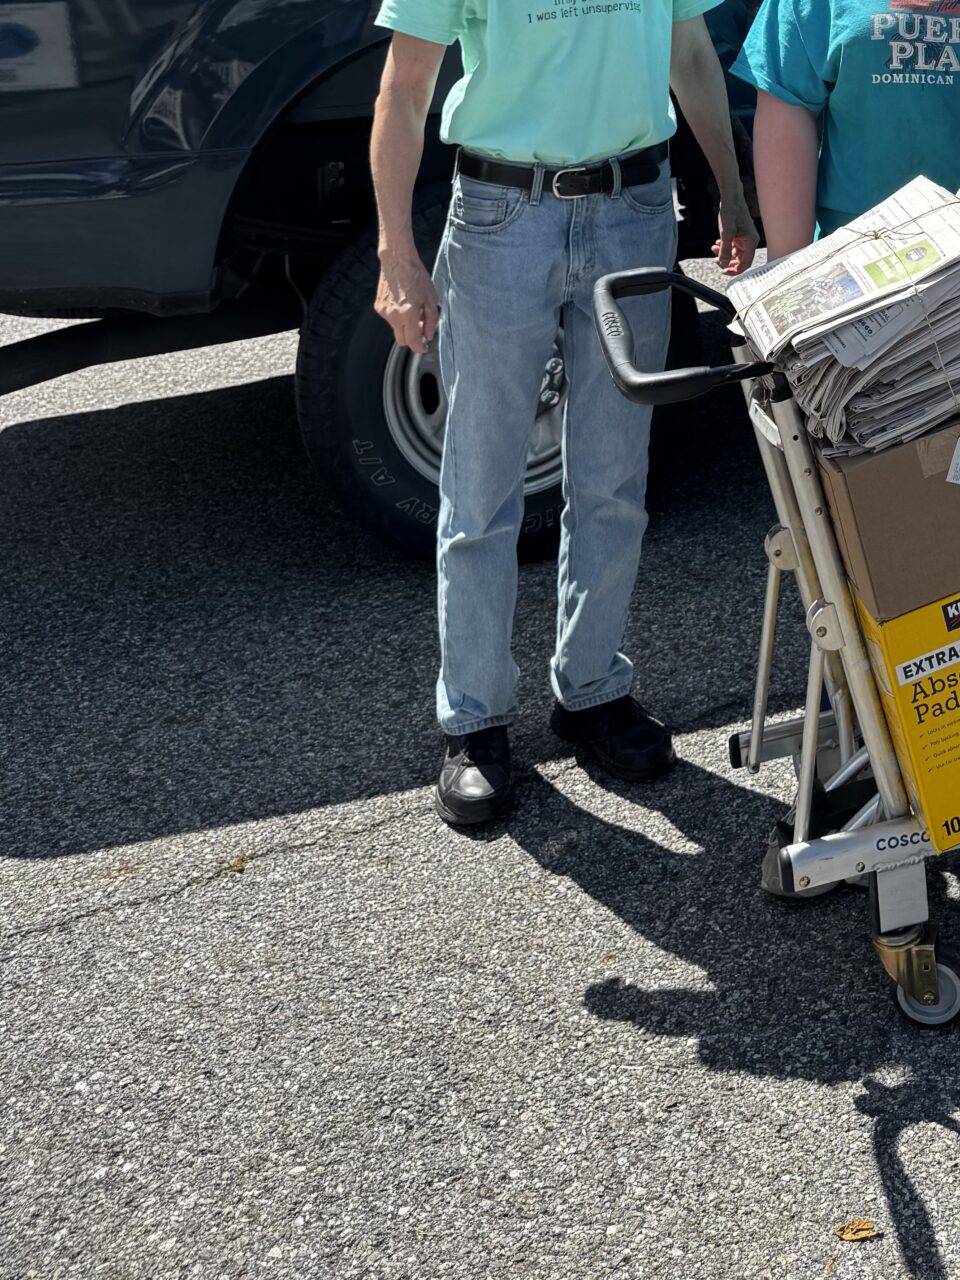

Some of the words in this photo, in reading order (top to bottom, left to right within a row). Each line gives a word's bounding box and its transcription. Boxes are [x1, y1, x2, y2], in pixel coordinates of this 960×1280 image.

[528, 13, 532, 23] I
[536, 12, 557, 22] was
[561, 7, 578, 19] left
[872, 73, 954, 85] DOMINICAN
